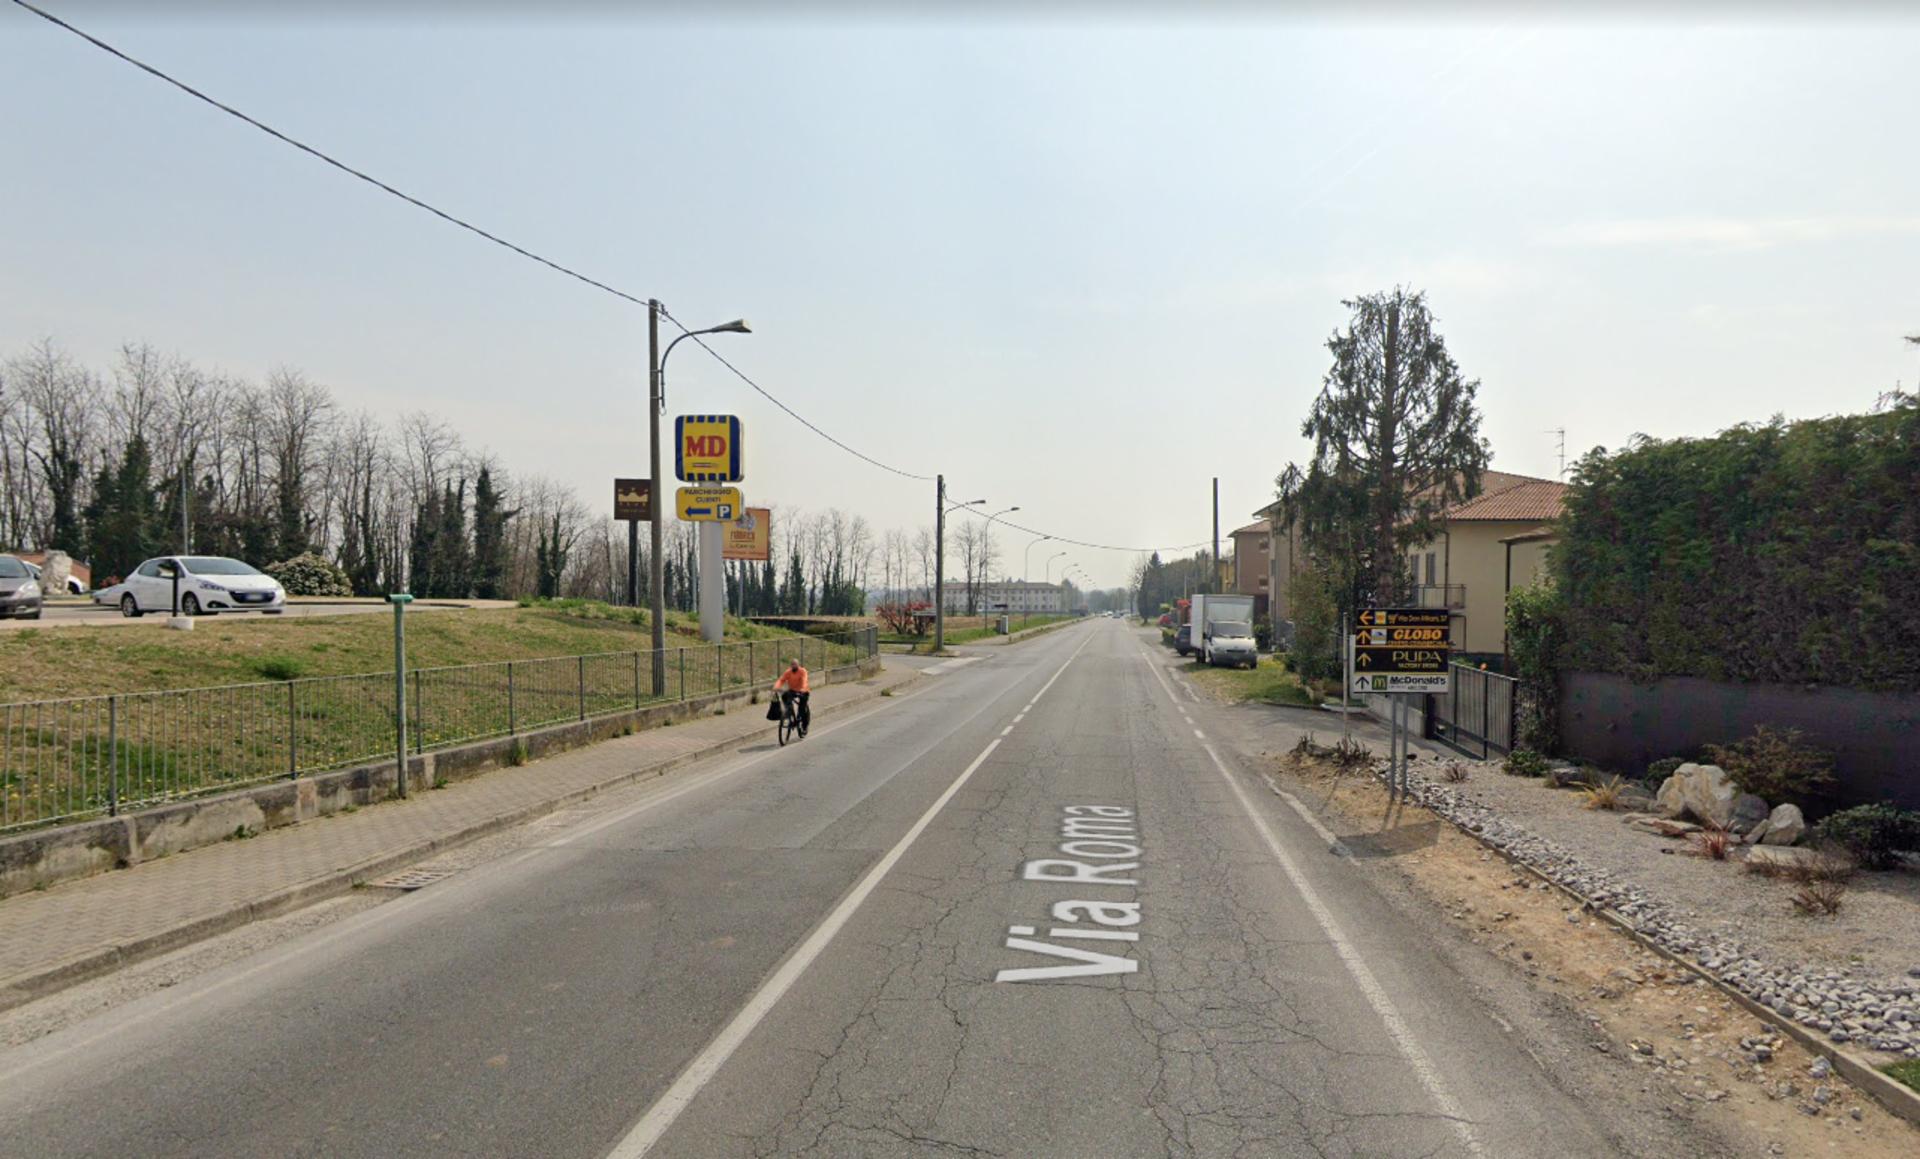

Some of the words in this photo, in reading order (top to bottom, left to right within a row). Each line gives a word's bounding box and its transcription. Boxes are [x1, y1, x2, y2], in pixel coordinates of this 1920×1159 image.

[685, 436, 727, 458] MD
[1393, 629, 1442, 640] GLOBO
[1392, 651, 1442, 662] PUPA
[1390, 676, 1446, 685] McDonald's
